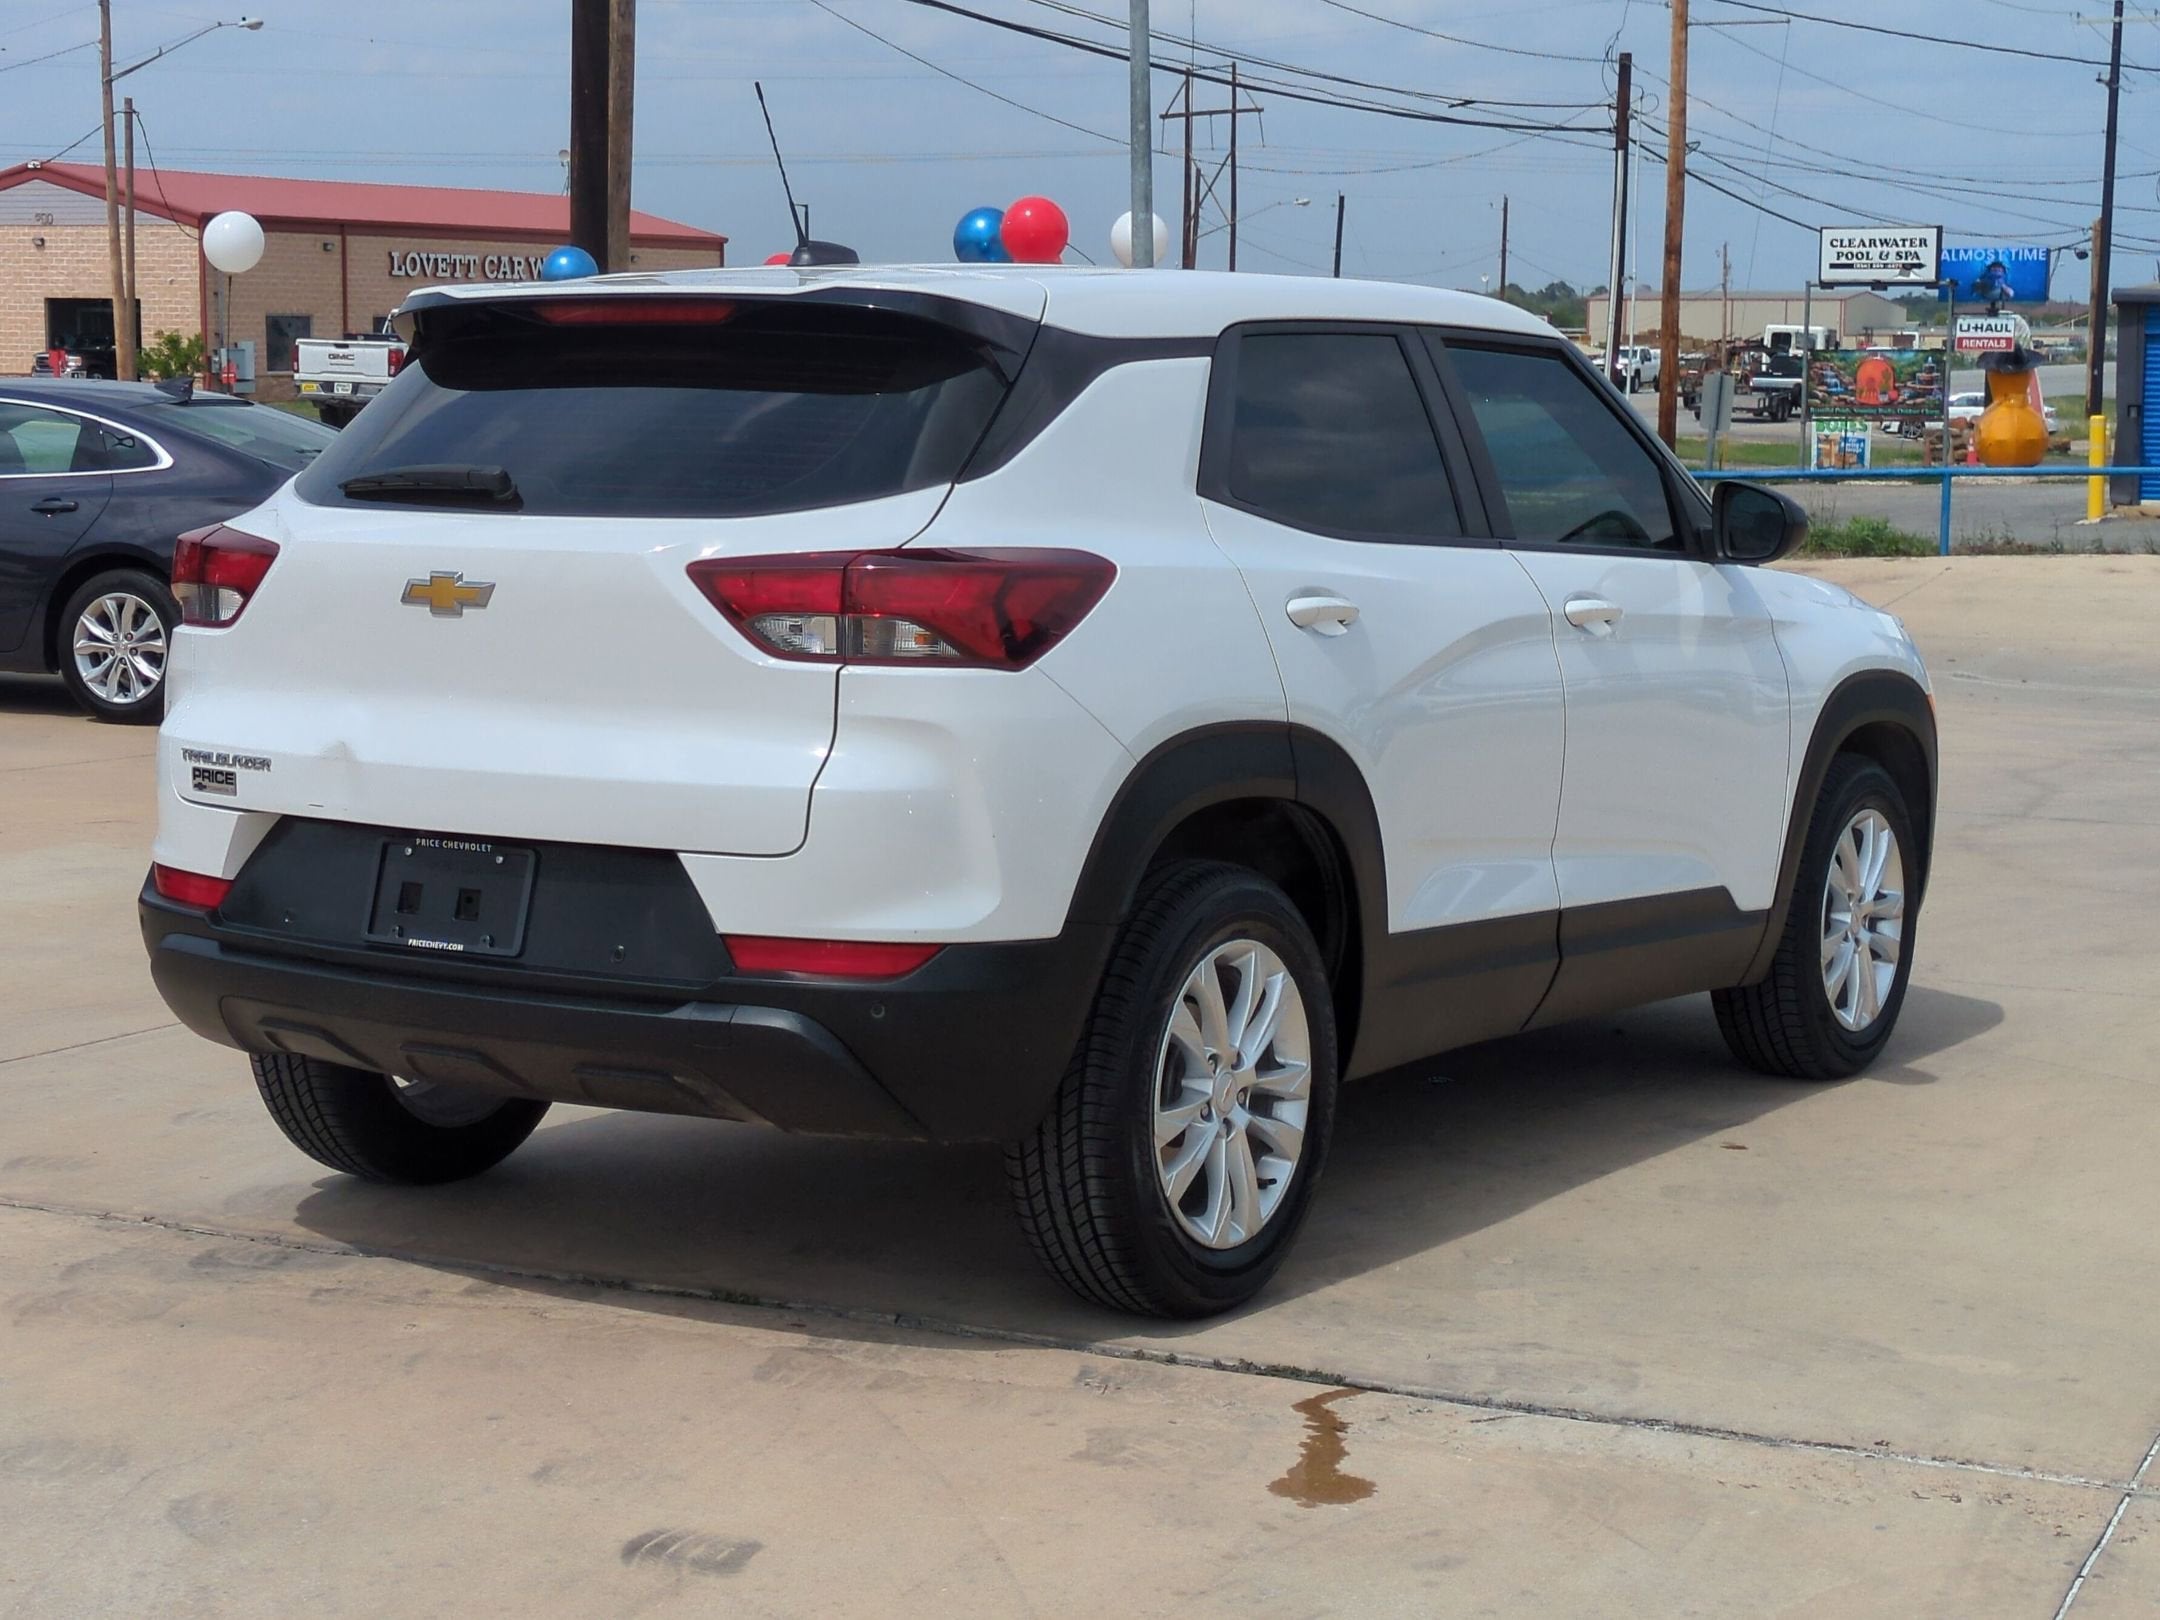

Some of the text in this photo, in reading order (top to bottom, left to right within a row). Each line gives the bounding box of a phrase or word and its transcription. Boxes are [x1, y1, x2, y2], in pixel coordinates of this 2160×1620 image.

[1829, 238, 1928, 249] CLEARWATER
[1836, 250, 1921, 261] POOL & SPA
[1940, 248, 2047, 262] ALMOST TIME
[391, 251, 479, 279] LOVETT
[484, 254, 526, 280] CAR
[1959, 323, 2013, 333] U-HAUL
[1962, 339, 2007, 349] RENTALS
[328, 353, 355, 361] GMC
[181, 748, 271, 772] TRAILBLAZER
[193, 767, 235, 786] PRICE
[416, 838, 492, 852] PRICE CHEVROLET
[408, 938, 464, 951] PRICECHEVY.COM
